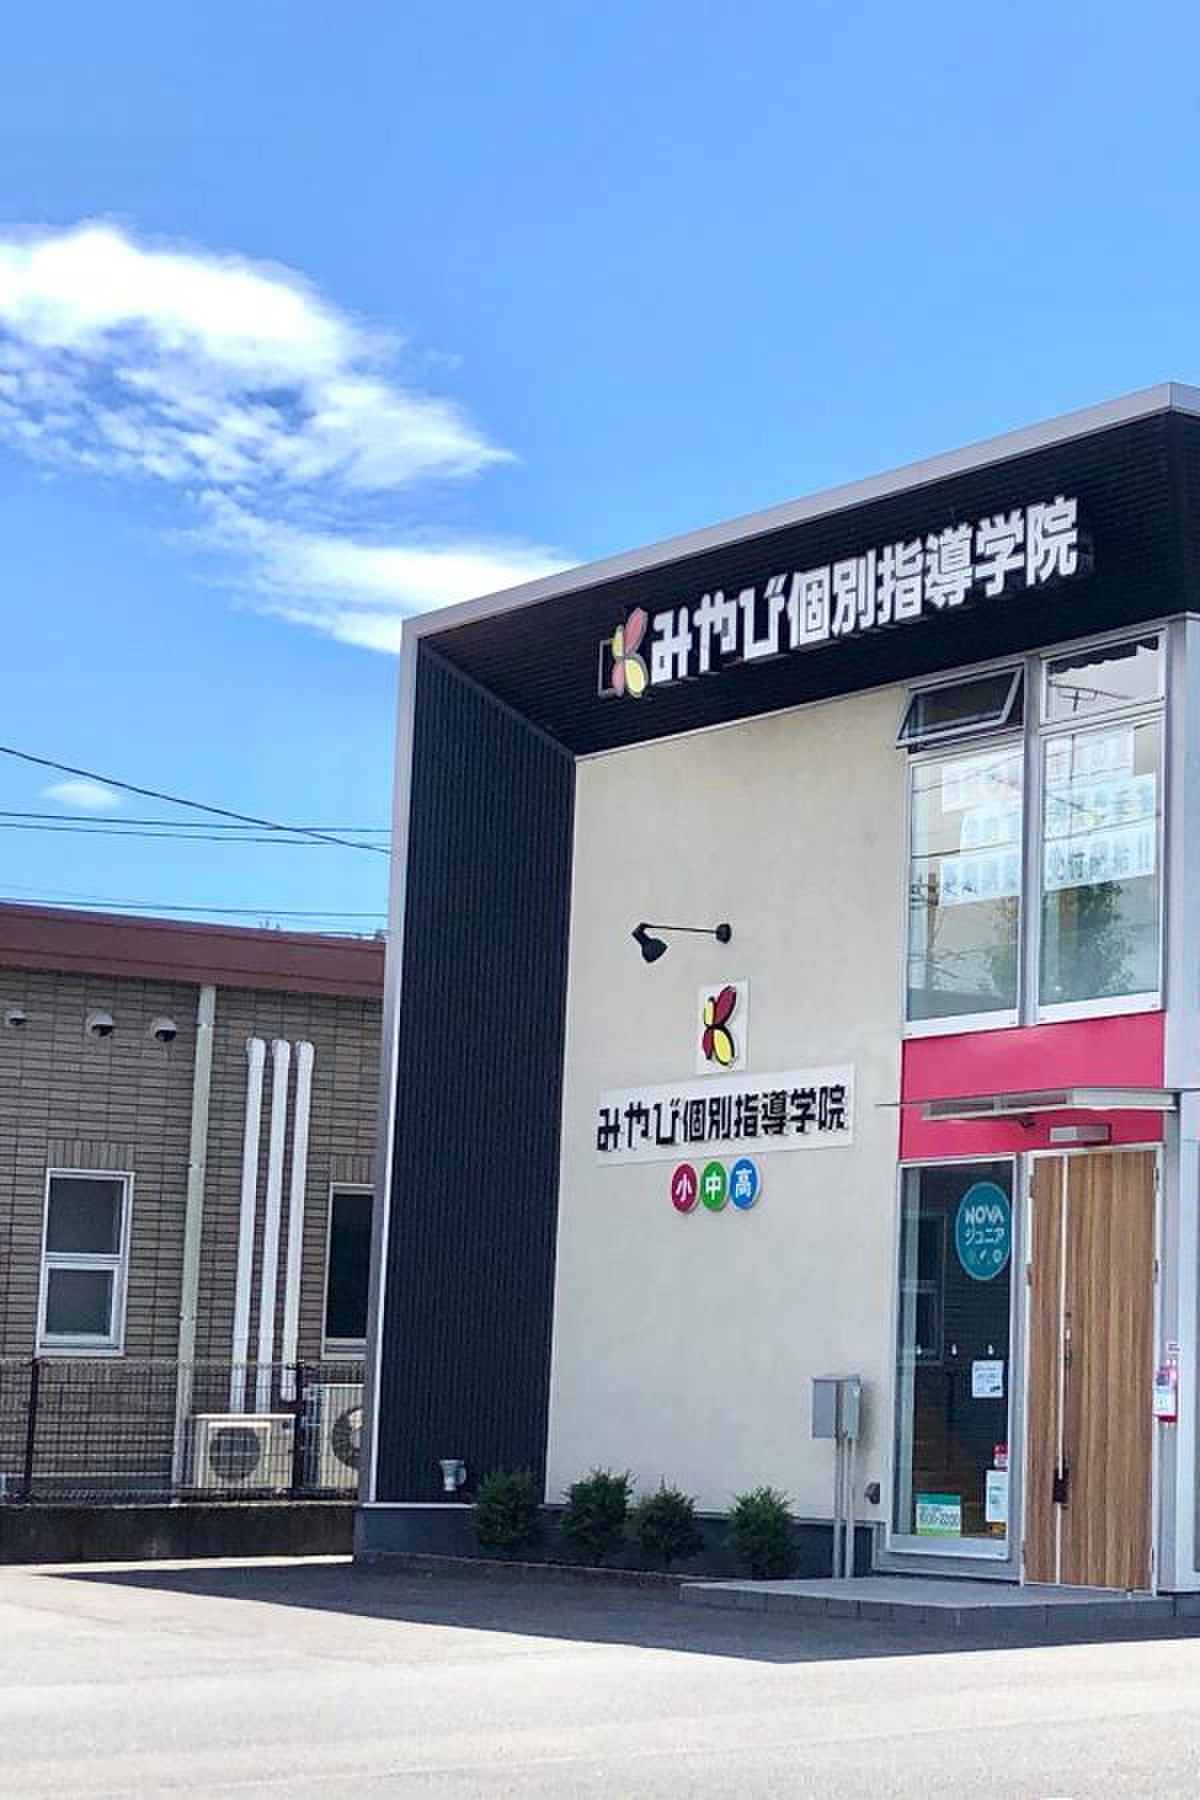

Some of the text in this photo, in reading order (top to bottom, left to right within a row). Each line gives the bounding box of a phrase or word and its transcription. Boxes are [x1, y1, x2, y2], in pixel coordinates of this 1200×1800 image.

[650, 496, 1078, 684] みやび個別指導学院
[597, 1084, 847, 1150] みやび個別指導学院
[964, 1204, 1005, 1225] NOVA
